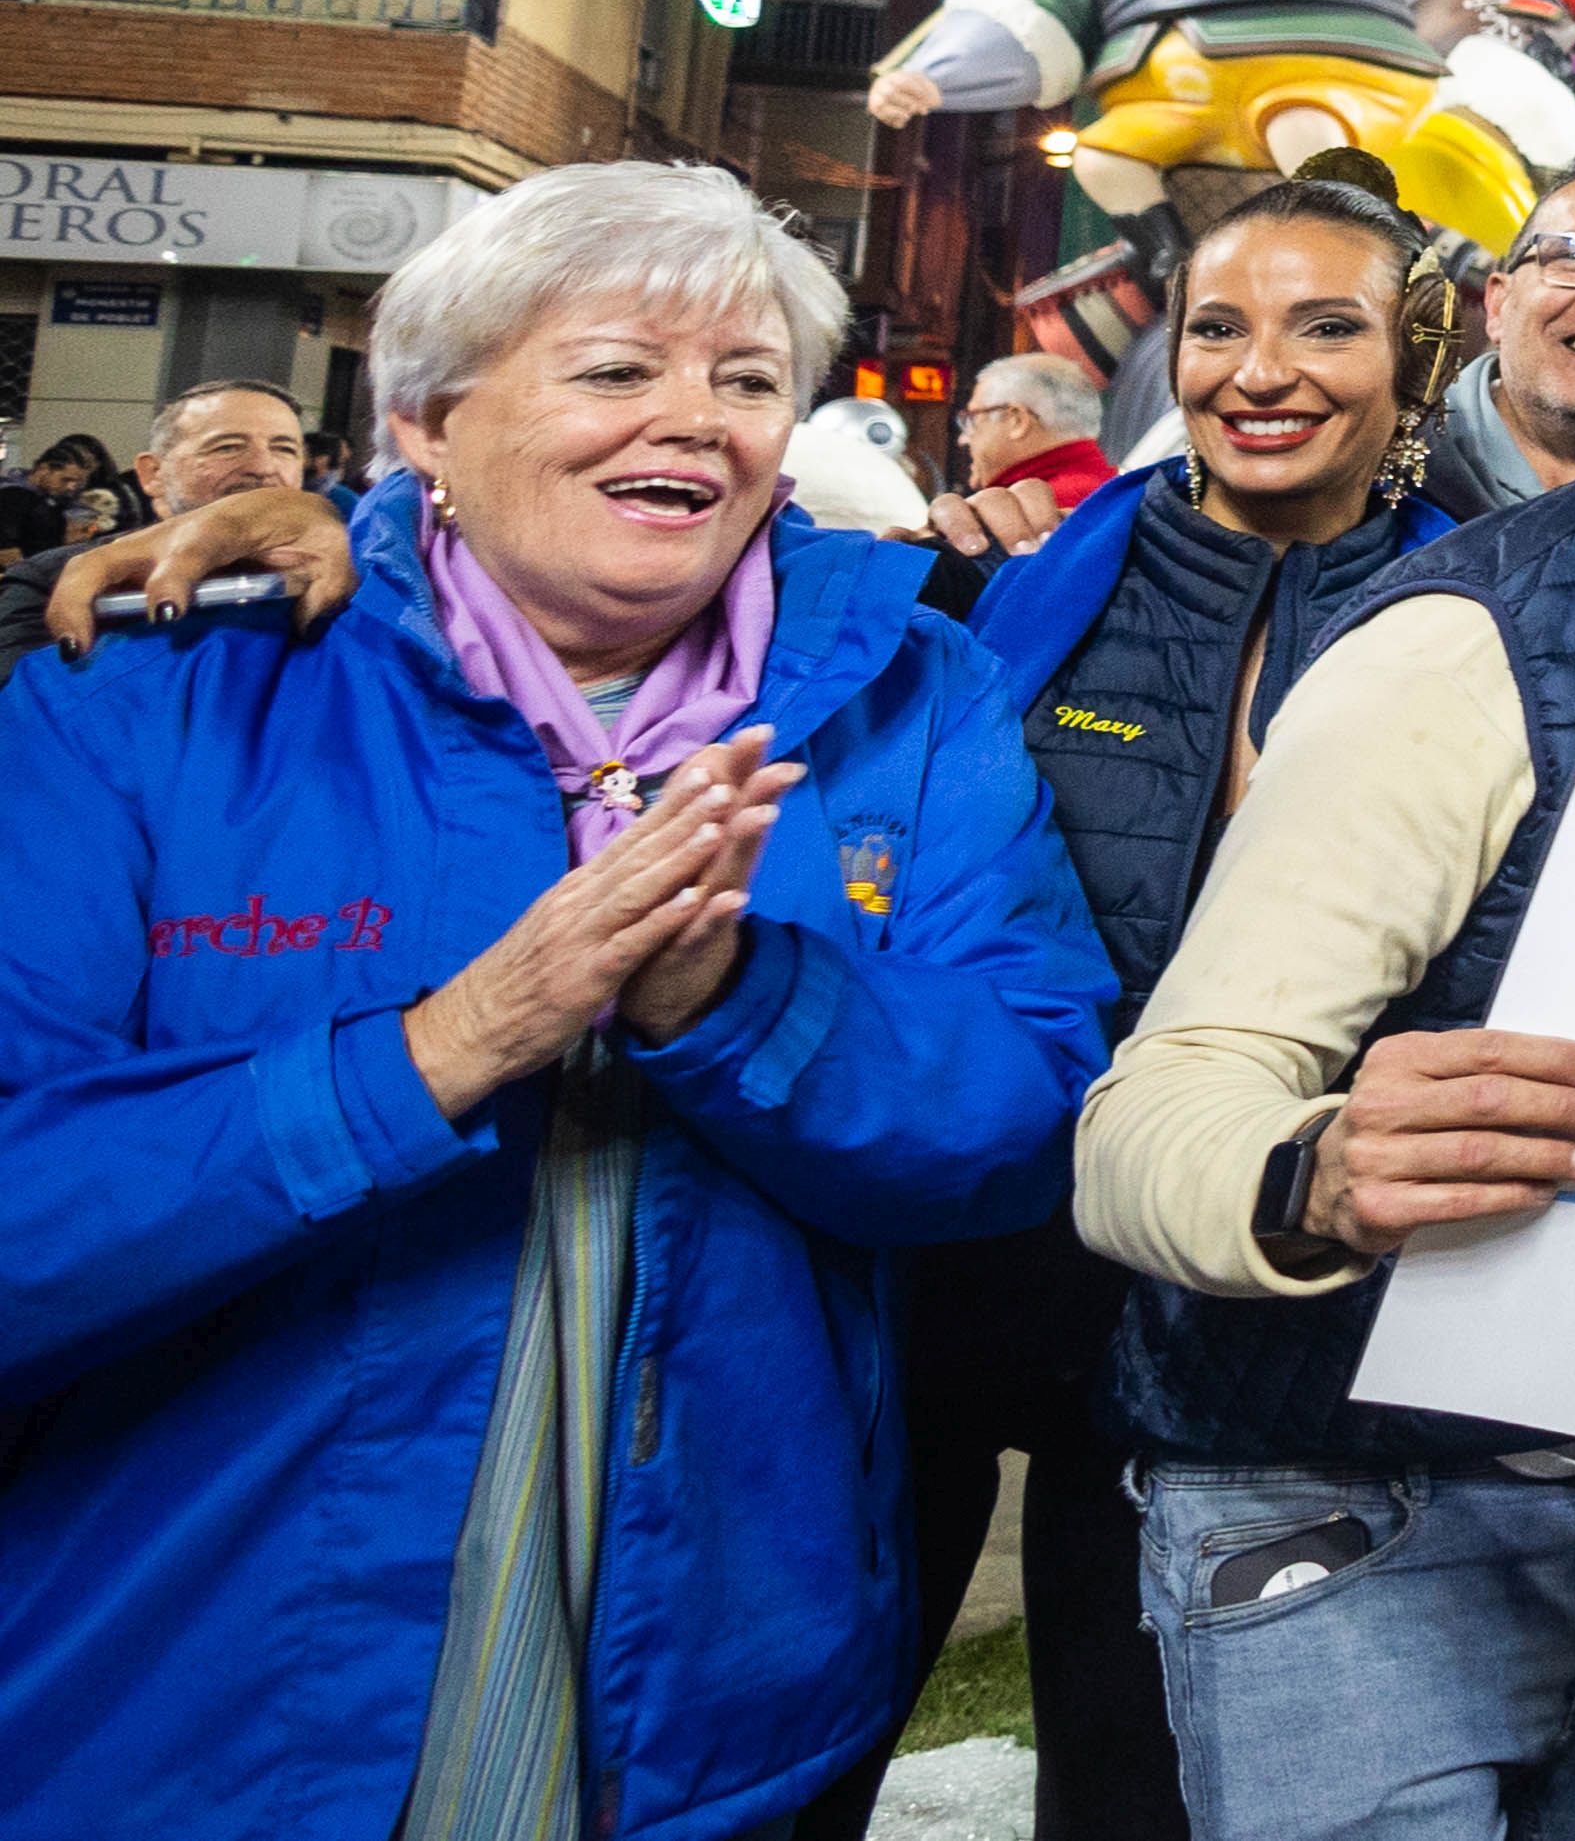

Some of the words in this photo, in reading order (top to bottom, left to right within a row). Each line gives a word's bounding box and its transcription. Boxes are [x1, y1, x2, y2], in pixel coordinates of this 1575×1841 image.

[0, 201, 208, 249] EROS
[1055, 706, 1147, 742] Mary
[149, 894, 329, 958] erche
